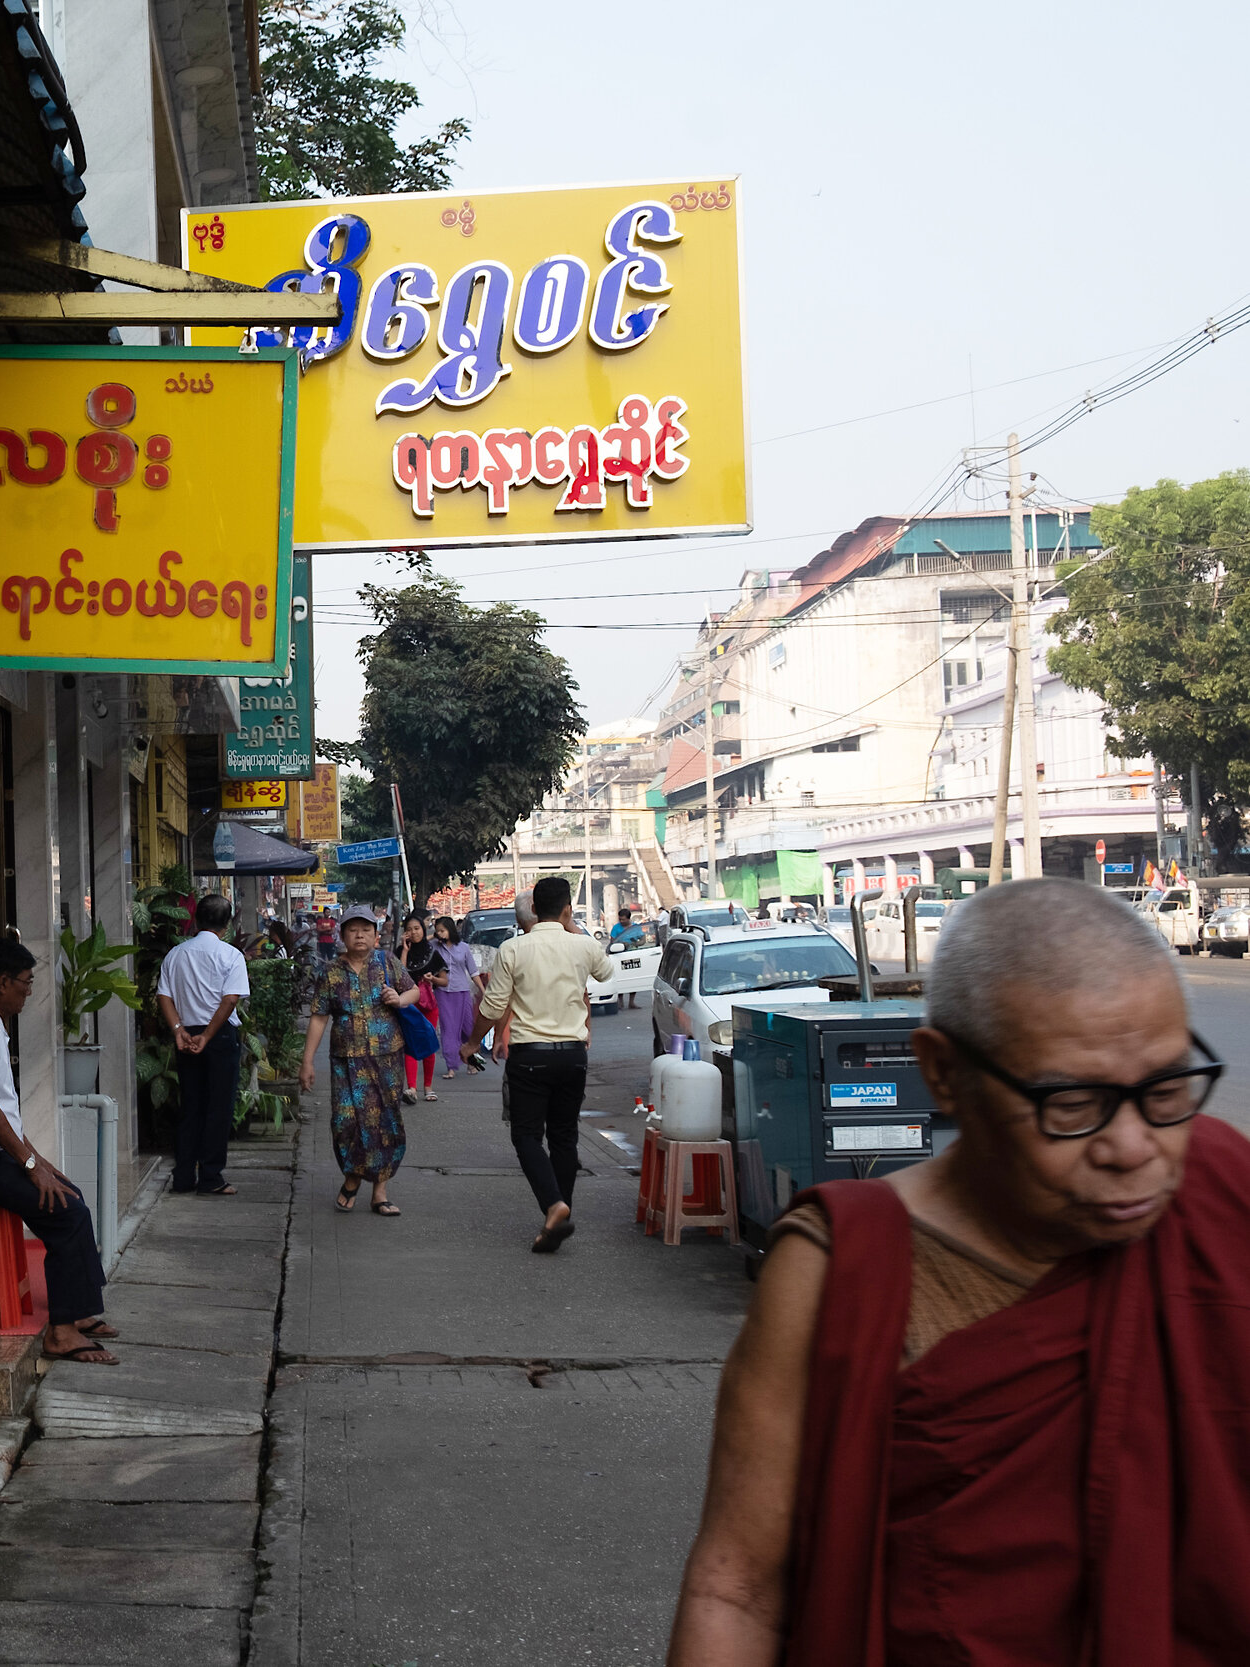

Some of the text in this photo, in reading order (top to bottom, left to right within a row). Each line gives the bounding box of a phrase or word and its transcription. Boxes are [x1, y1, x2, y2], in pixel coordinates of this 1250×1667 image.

[440, 200, 477, 238] ဓမ္မံ
[669, 183, 733, 214] သံဃံ
[164, 371, 215, 395] သံဃံ
[392, 393, 690, 518] ရတနာရွှေဆိုင်
[851, 1085, 892, 1095] JAPAN
